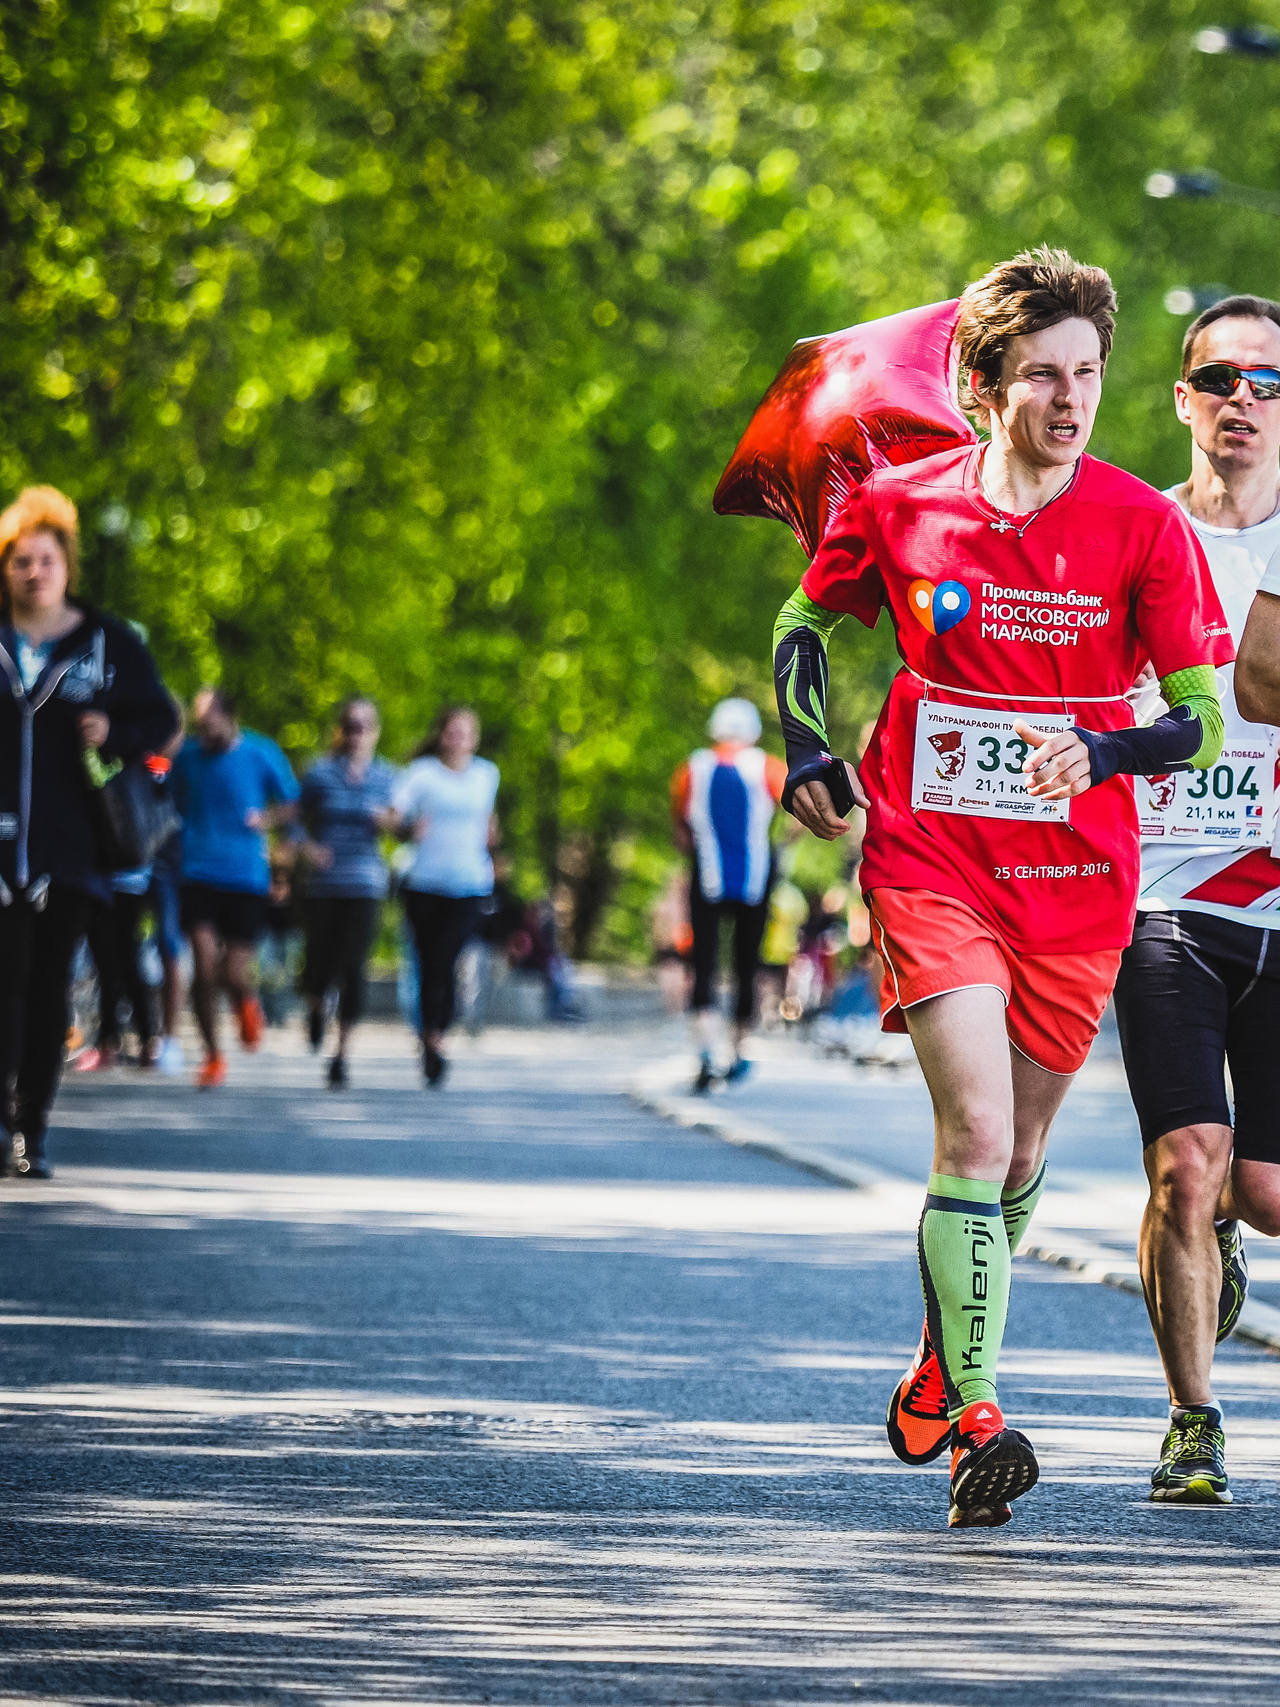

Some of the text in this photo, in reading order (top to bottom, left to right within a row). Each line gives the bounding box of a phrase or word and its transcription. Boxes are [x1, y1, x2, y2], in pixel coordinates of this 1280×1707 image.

[981, 582, 1103, 608] Промсвязьбанк
[980, 602, 1111, 628] МОСКОВСКИЙ
[980, 622, 1079, 647] МАРАФОН
[928, 713, 1064, 734] УЛЬТРАМАРАФОН ПУ ОБЕДЫ
[976, 736, 1050, 774] 33
[1231, 750, 1266, 760] ПОБЕДЫ
[975, 778, 1005, 794] 21,1
[1186, 765, 1260, 801] 304
[994, 802, 1036, 811] MEGASPORT
[1186, 806, 1212, 820] 21,1
[993, 862, 1111, 880] 25 СЕНТЯБРЯ 2016
